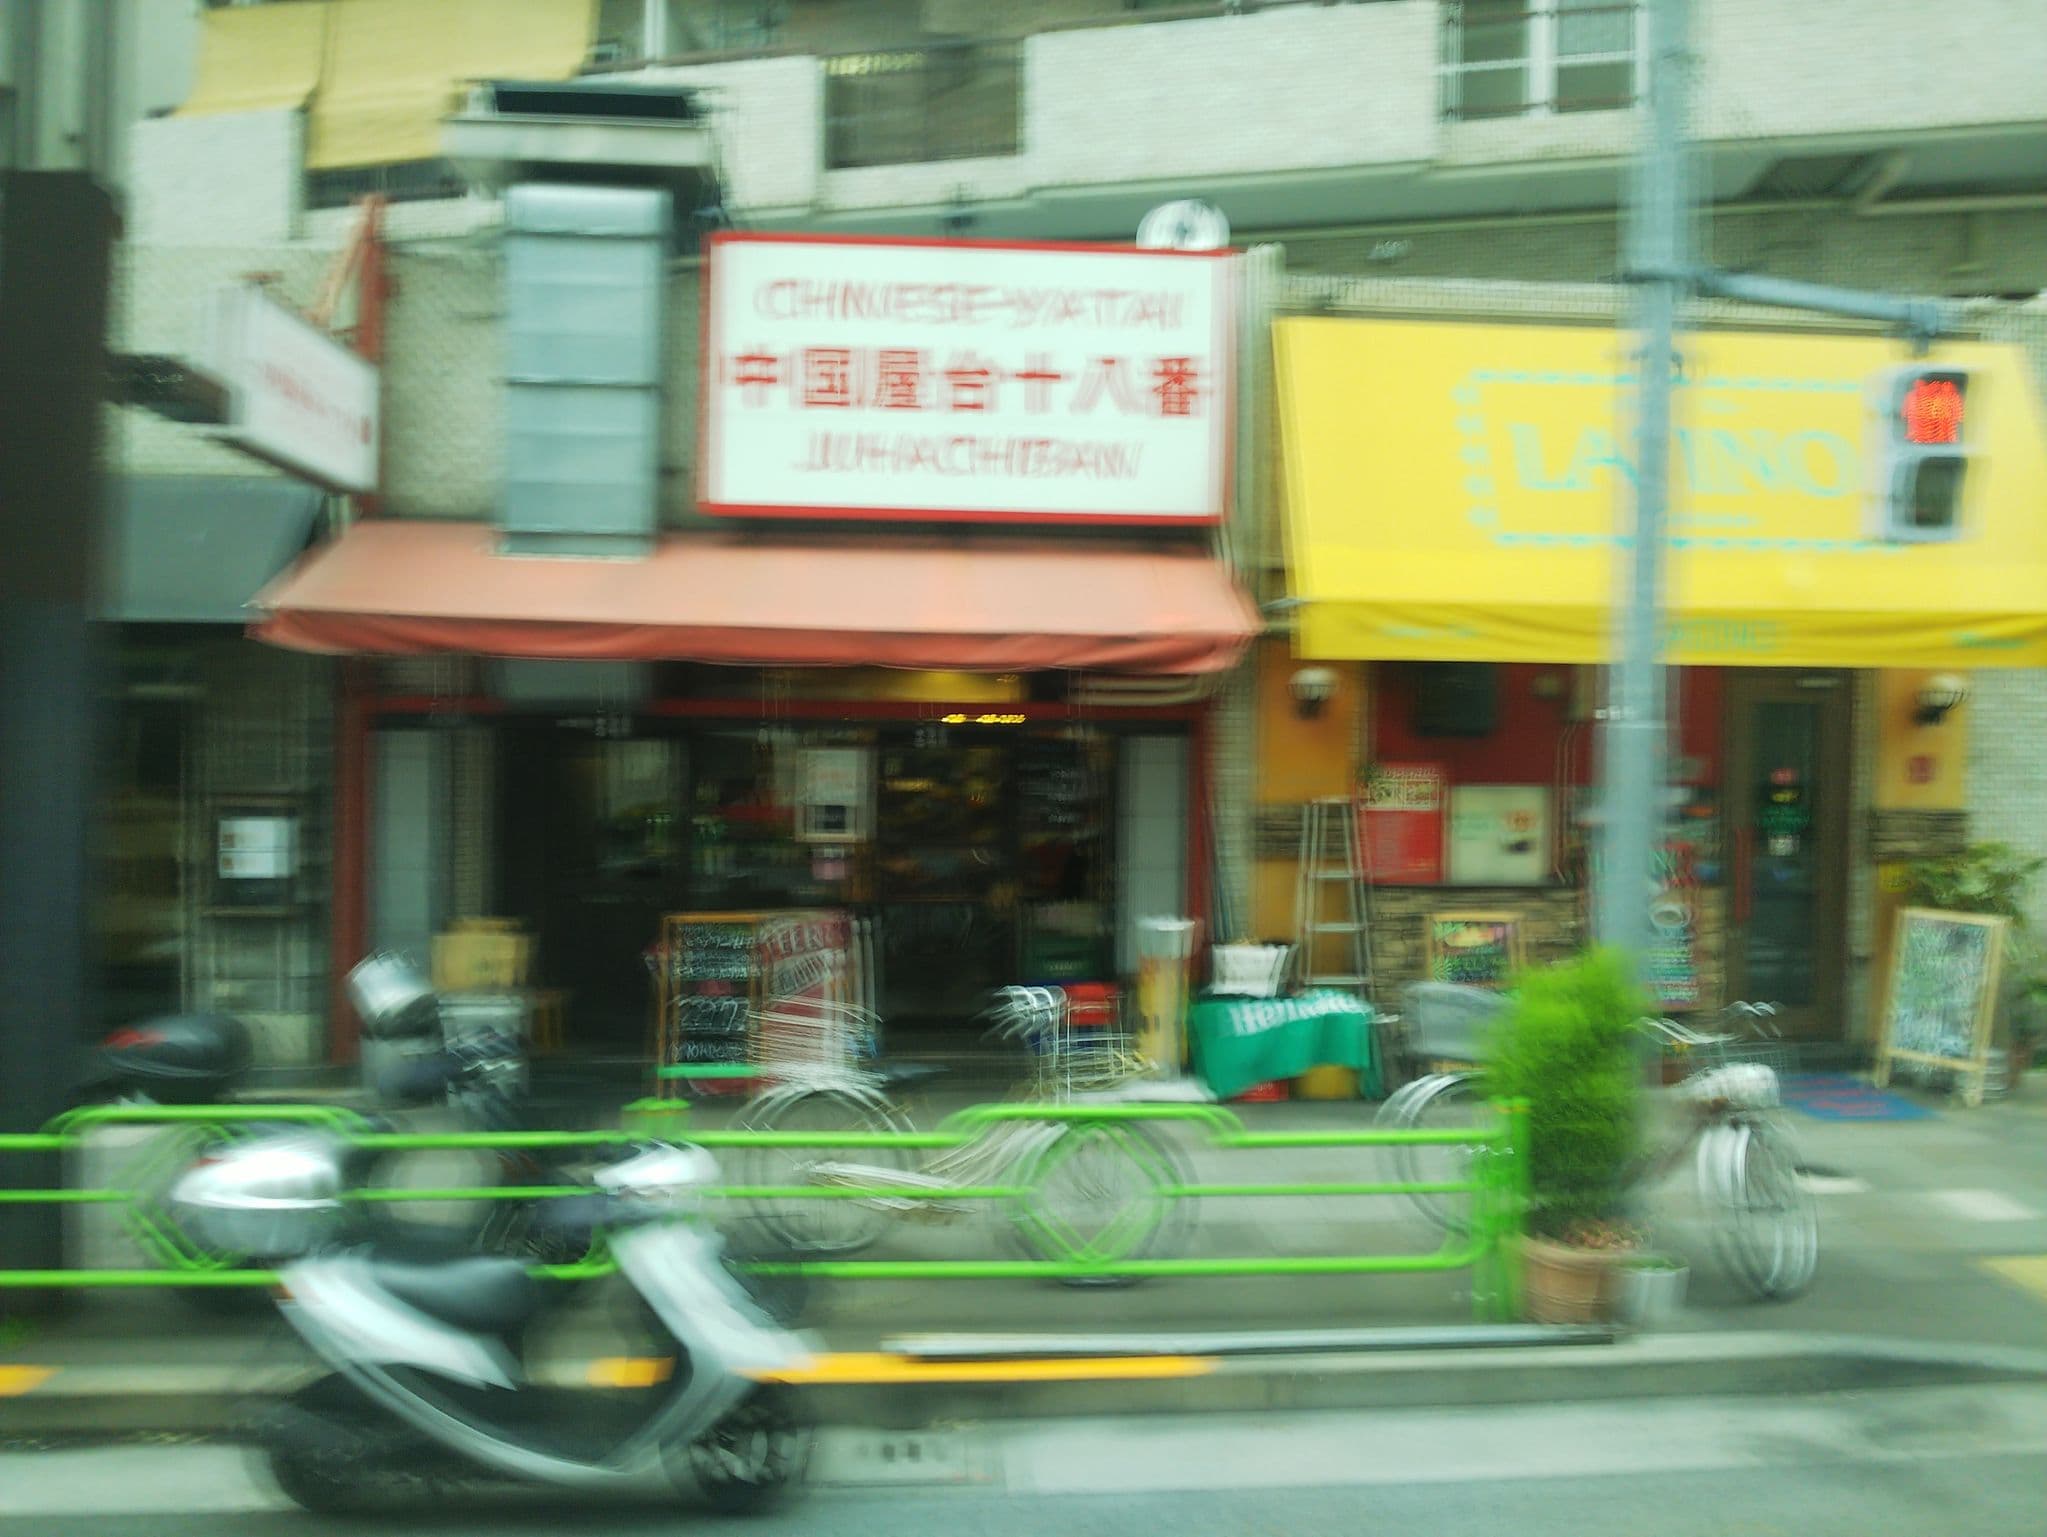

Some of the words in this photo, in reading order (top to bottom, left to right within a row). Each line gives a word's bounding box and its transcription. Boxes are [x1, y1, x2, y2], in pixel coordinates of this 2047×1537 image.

[732, 345, 1204, 418] 中国屋台十八番
[1508, 422, 1861, 497] LAINO
